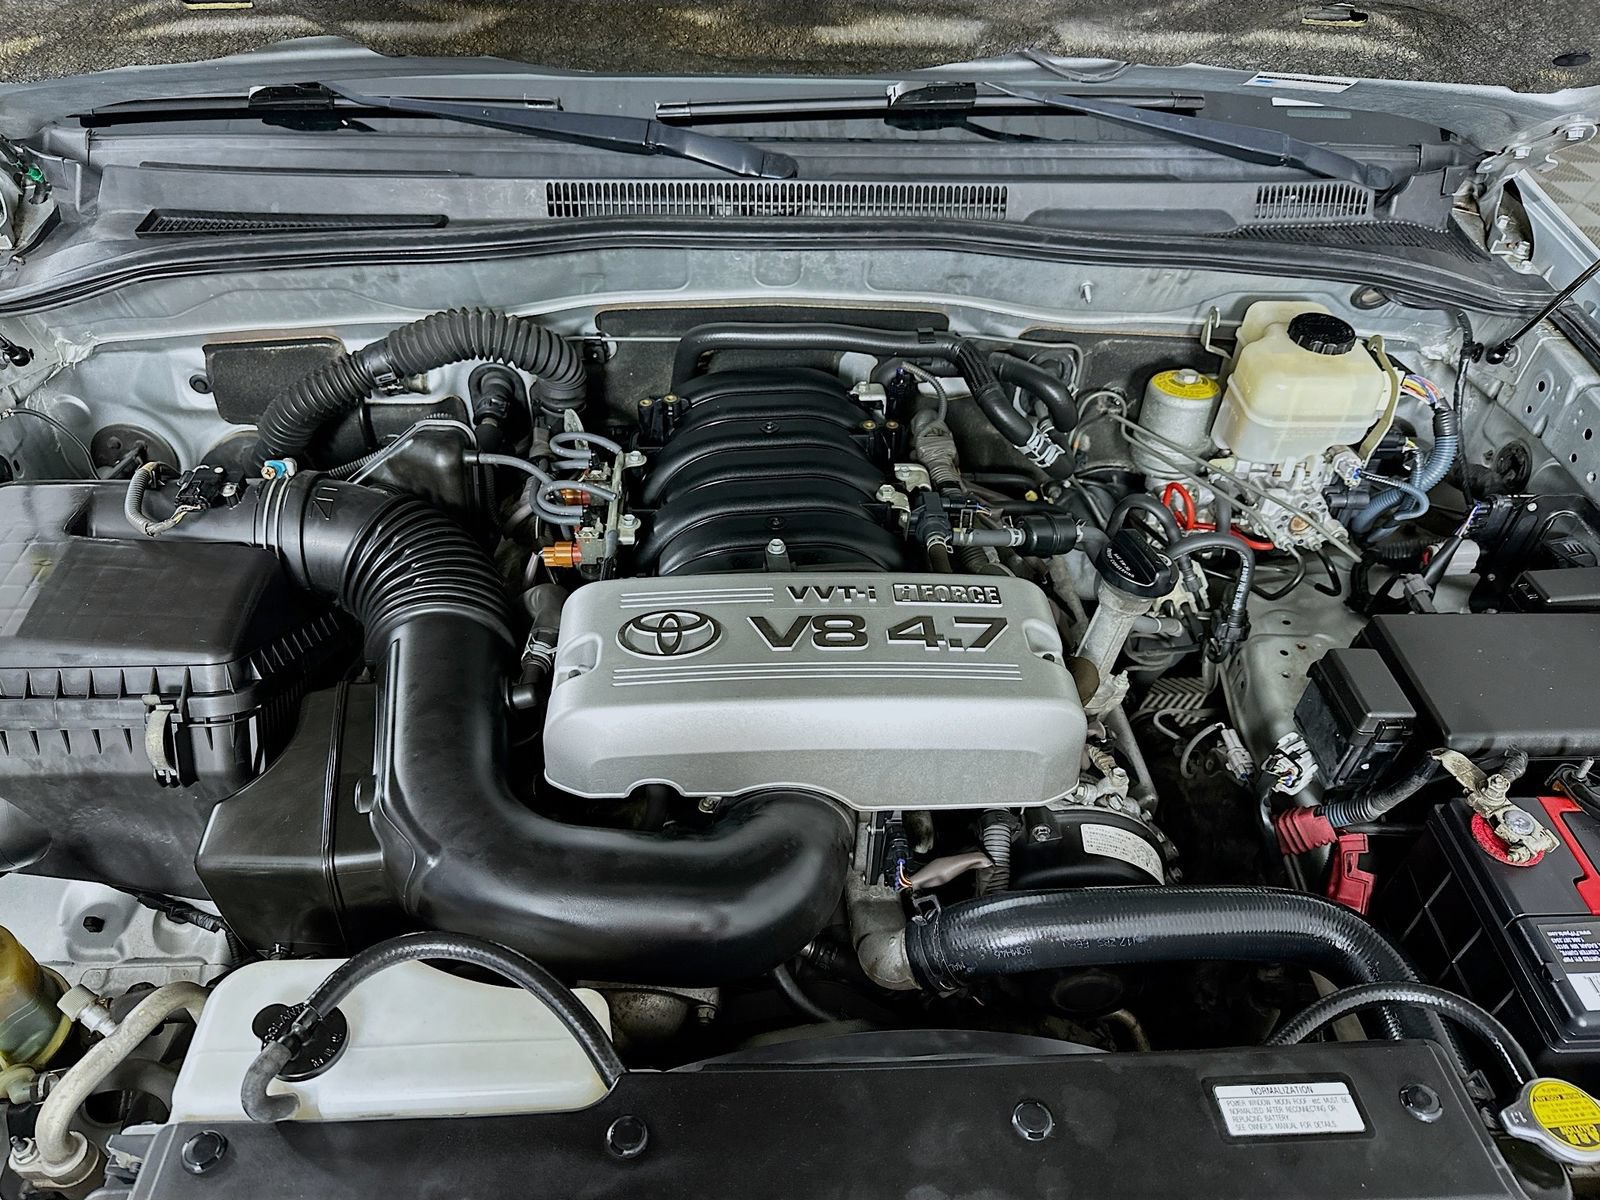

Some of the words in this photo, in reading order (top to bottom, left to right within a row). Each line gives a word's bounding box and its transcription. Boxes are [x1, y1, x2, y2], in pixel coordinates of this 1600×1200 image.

[785, 585, 877, 603] VVT-i
[746, 614, 869, 651] V8
[886, 615, 1009, 652] 4.7
[1249, 1086, 1314, 1096] NORMALIZATION
[1226, 1099, 1247, 1107] POWER
[1322, 1096, 1338, 1104] MUST
[1229, 1106, 1264, 1115] NORMALIZED
[1266, 1105, 1284, 1113] AFTER
[1285, 1104, 1327, 1112] RECONNECTING
[1232, 1115, 1263, 1123] REPLACING
[1274, 1121, 1299, 1130] MANUAL
